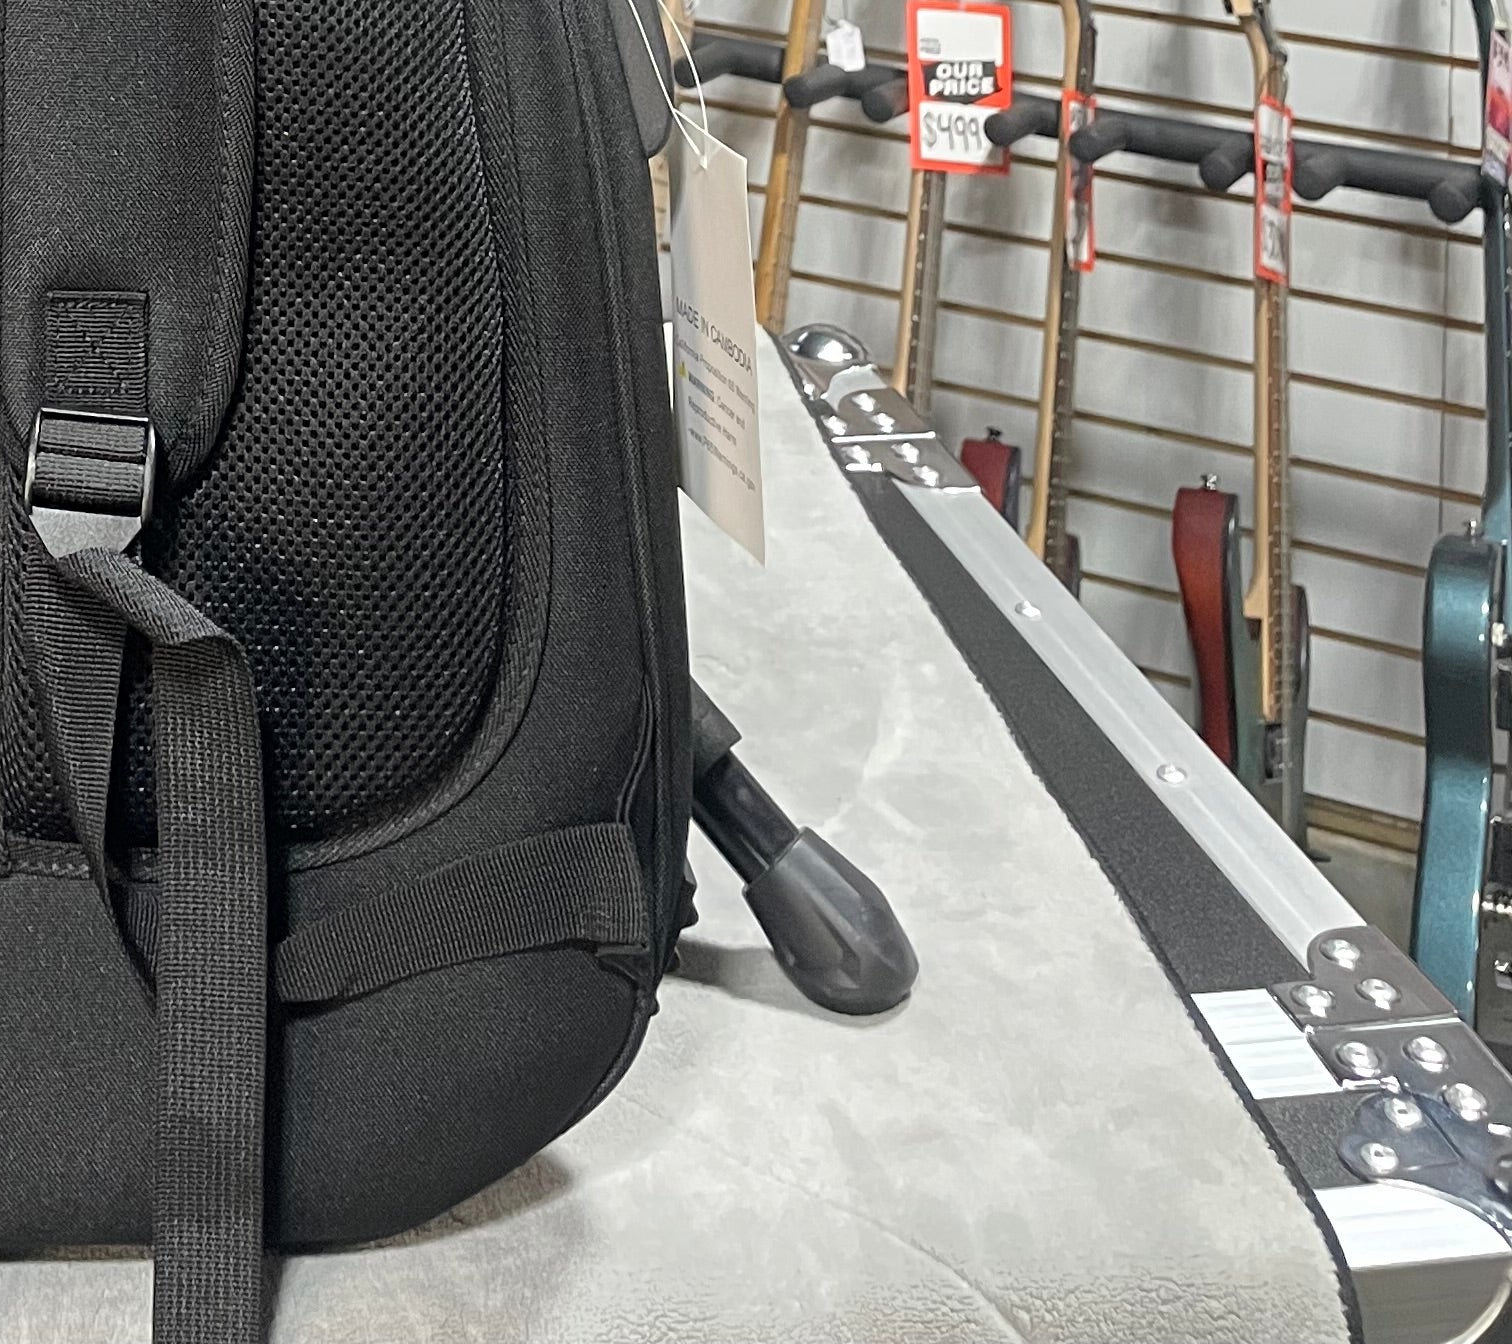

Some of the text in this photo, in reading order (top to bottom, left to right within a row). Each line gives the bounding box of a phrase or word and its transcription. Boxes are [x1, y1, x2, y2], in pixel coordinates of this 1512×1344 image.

[936, 62, 983, 80] OUR
[929, 77, 994, 97] PRICE
[923, 111, 982, 152] $499
[710, 324, 752, 374] CAMBODIA
